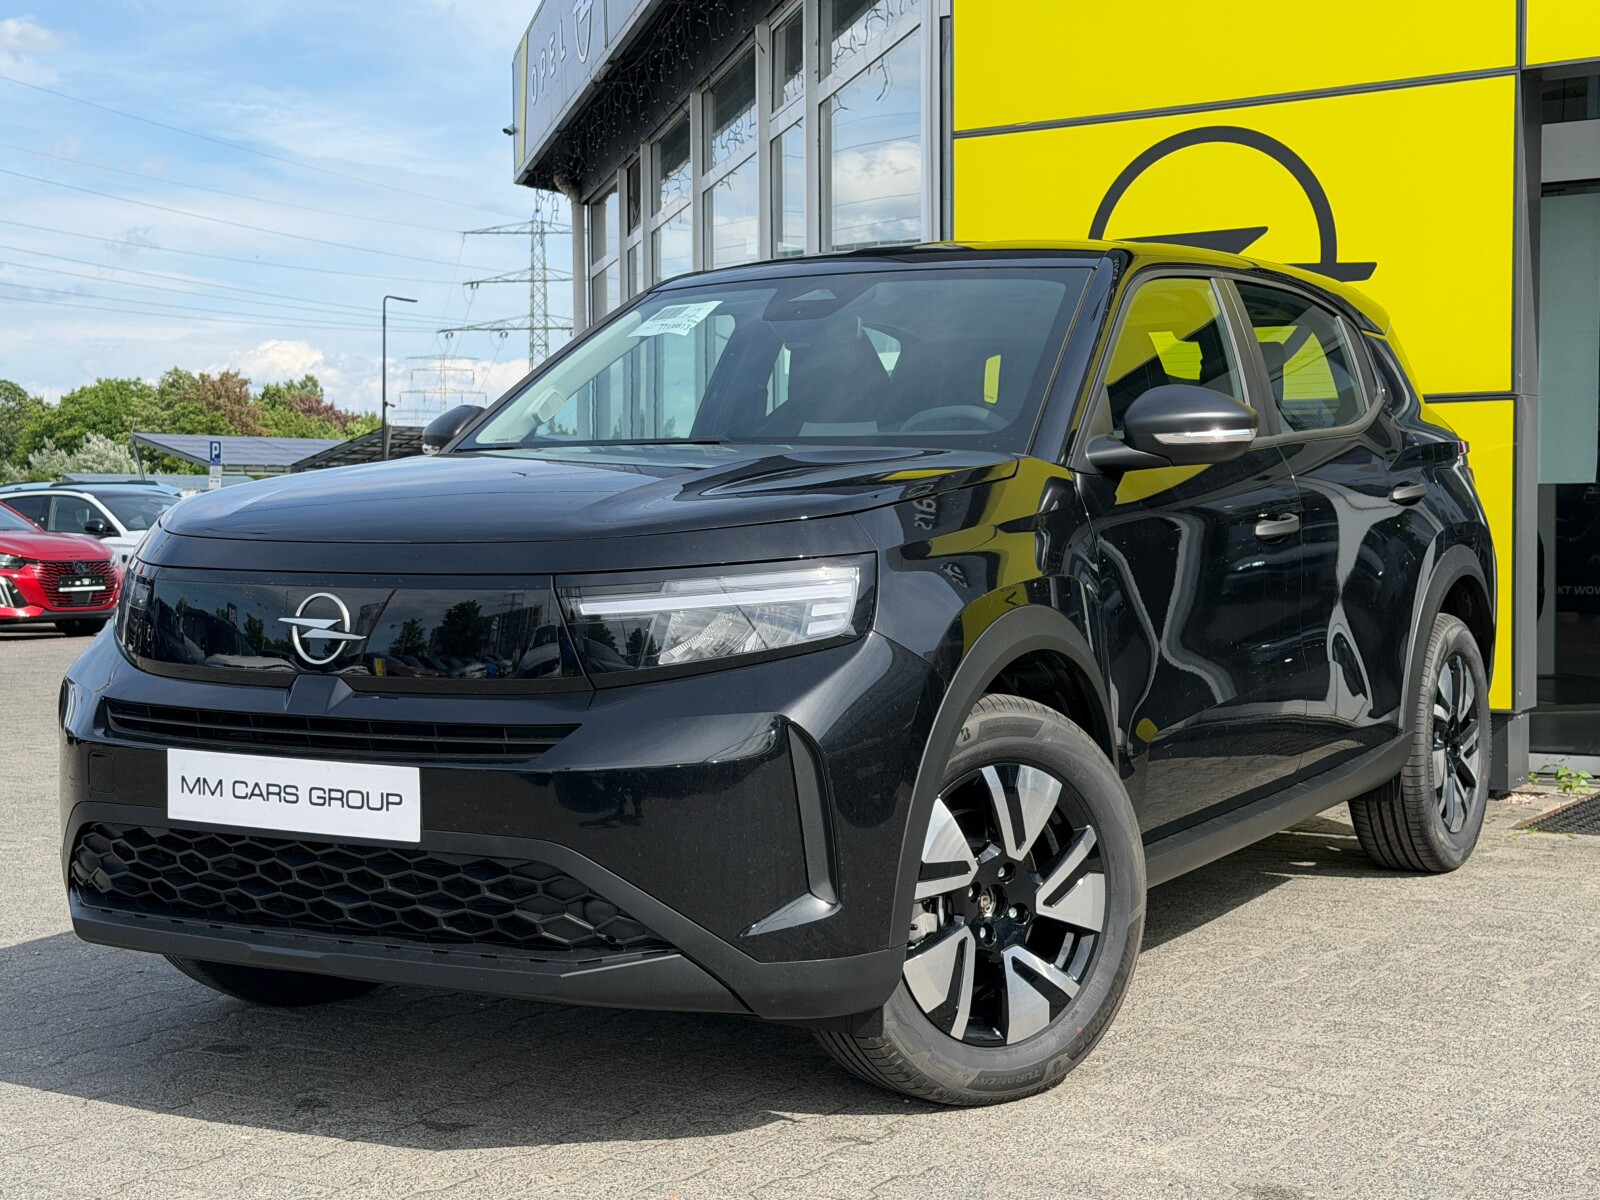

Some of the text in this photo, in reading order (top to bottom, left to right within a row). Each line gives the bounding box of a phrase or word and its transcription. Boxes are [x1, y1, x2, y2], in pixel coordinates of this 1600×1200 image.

[531, 19, 566, 105] OPEL
[211, 442, 220, 459] P
[181, 775, 404, 812] MM CARS GROUP
[977, 1069, 1041, 1086] TURANZA
